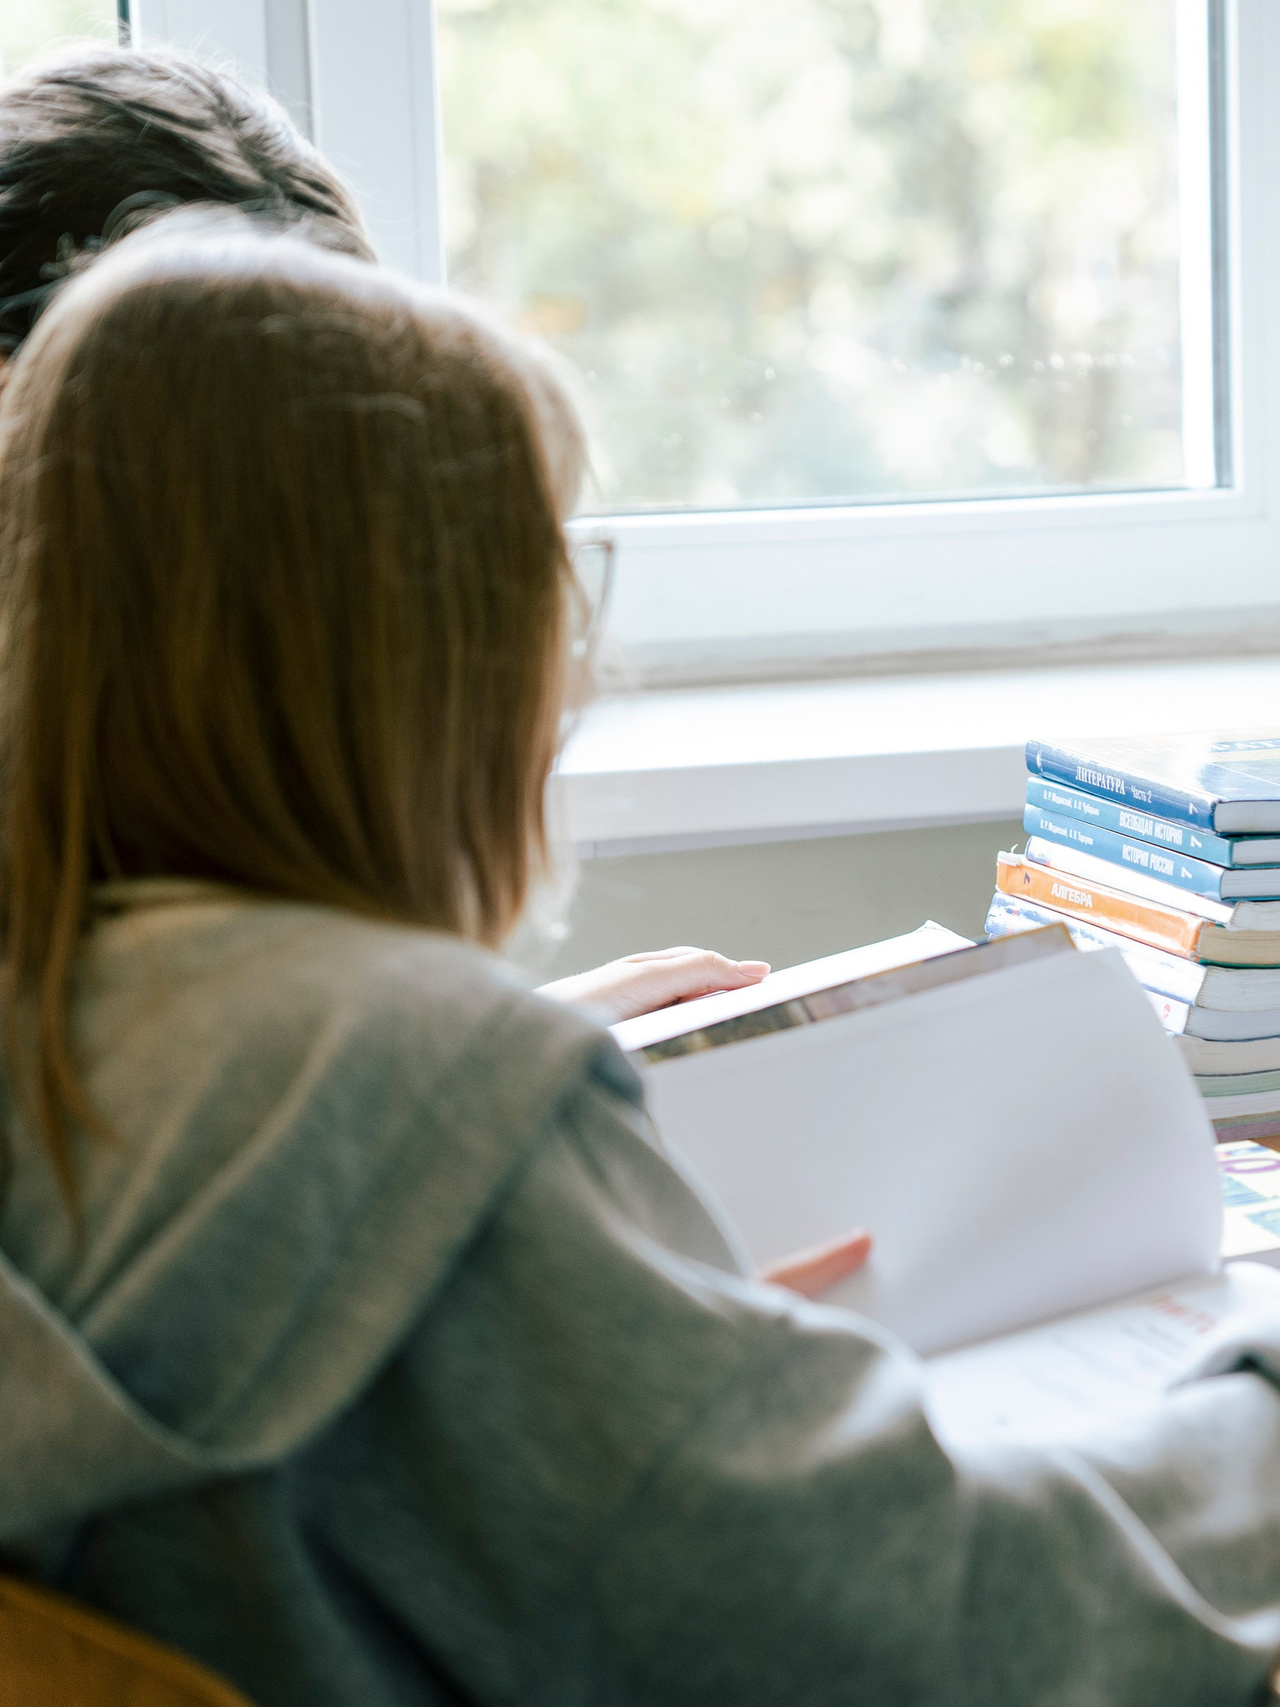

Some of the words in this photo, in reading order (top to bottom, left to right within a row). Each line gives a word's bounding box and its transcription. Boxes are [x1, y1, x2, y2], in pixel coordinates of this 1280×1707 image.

[1075, 765, 1126, 795] ЛИТЕРАТУРА
[1131, 785, 1147, 803] Часть
[1147, 790, 1153, 804] 2
[1188, 802, 1199, 815] 7
[1119, 811, 1154, 836] ВСЕОБЩАЯ
[1154, 822, 1183, 846] ИСТОРИЯ
[1190, 835, 1203, 849] 7
[1122, 844, 1150, 870] ИСТОРИЯ
[1150, 854, 1175, 877] РОССИИ
[1181, 866, 1193, 879] 7
[1051, 883, 1093, 908] АЛГЕБРА
